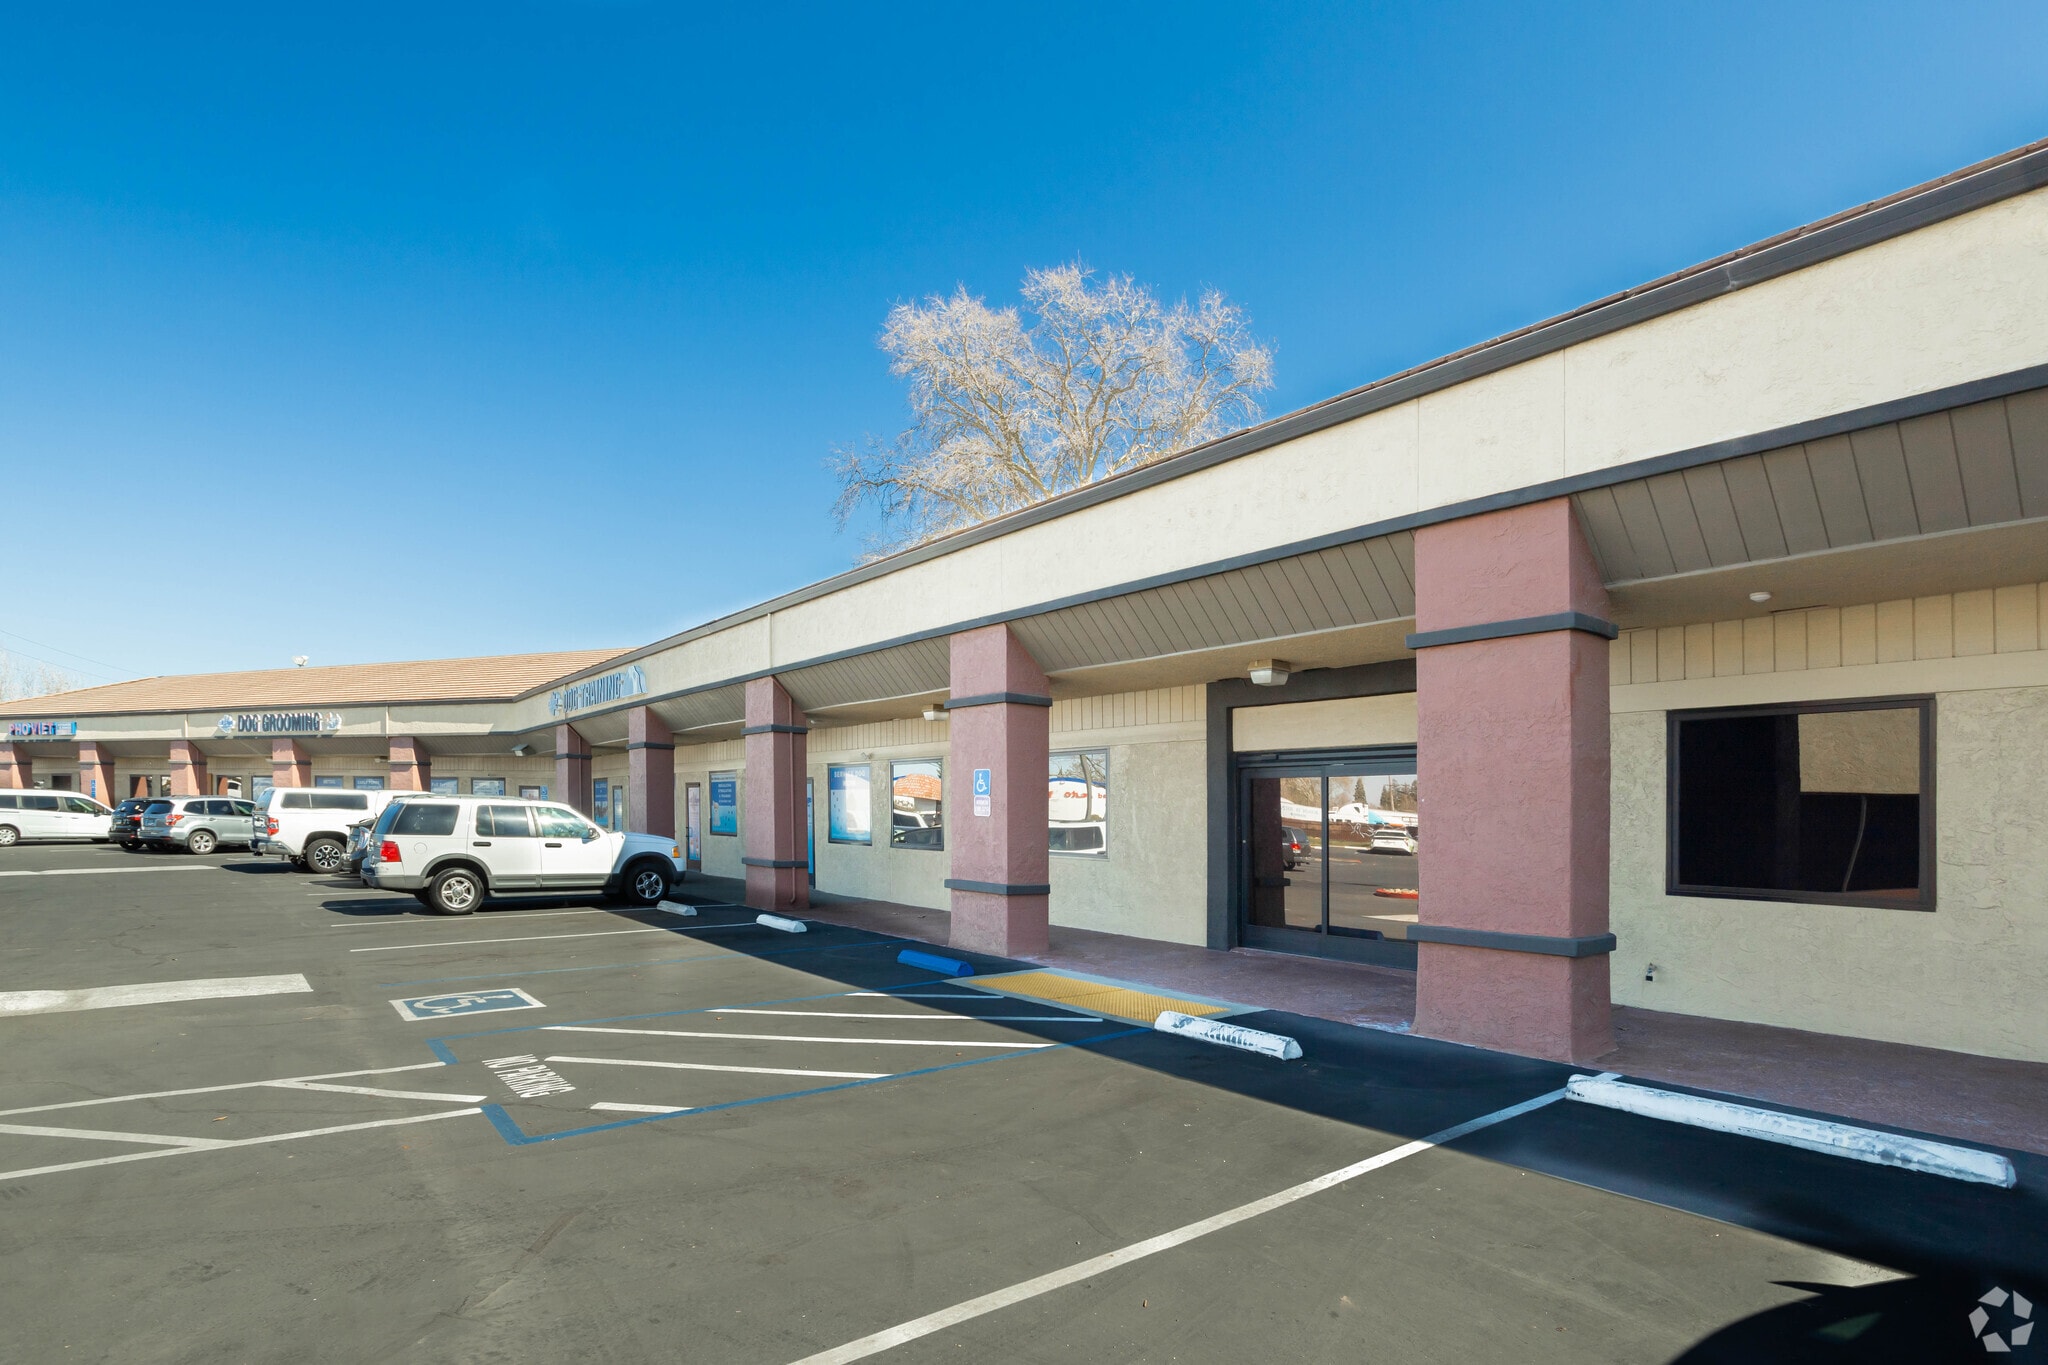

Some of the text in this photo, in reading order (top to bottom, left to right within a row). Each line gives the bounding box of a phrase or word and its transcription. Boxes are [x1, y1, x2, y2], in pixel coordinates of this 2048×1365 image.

[563, 673, 621, 713] DOG TRAINING
[238, 712, 320, 732] DOG GROOMING
[482, 1054, 538, 1068] NO
[494, 1065, 576, 1098] PARKING
